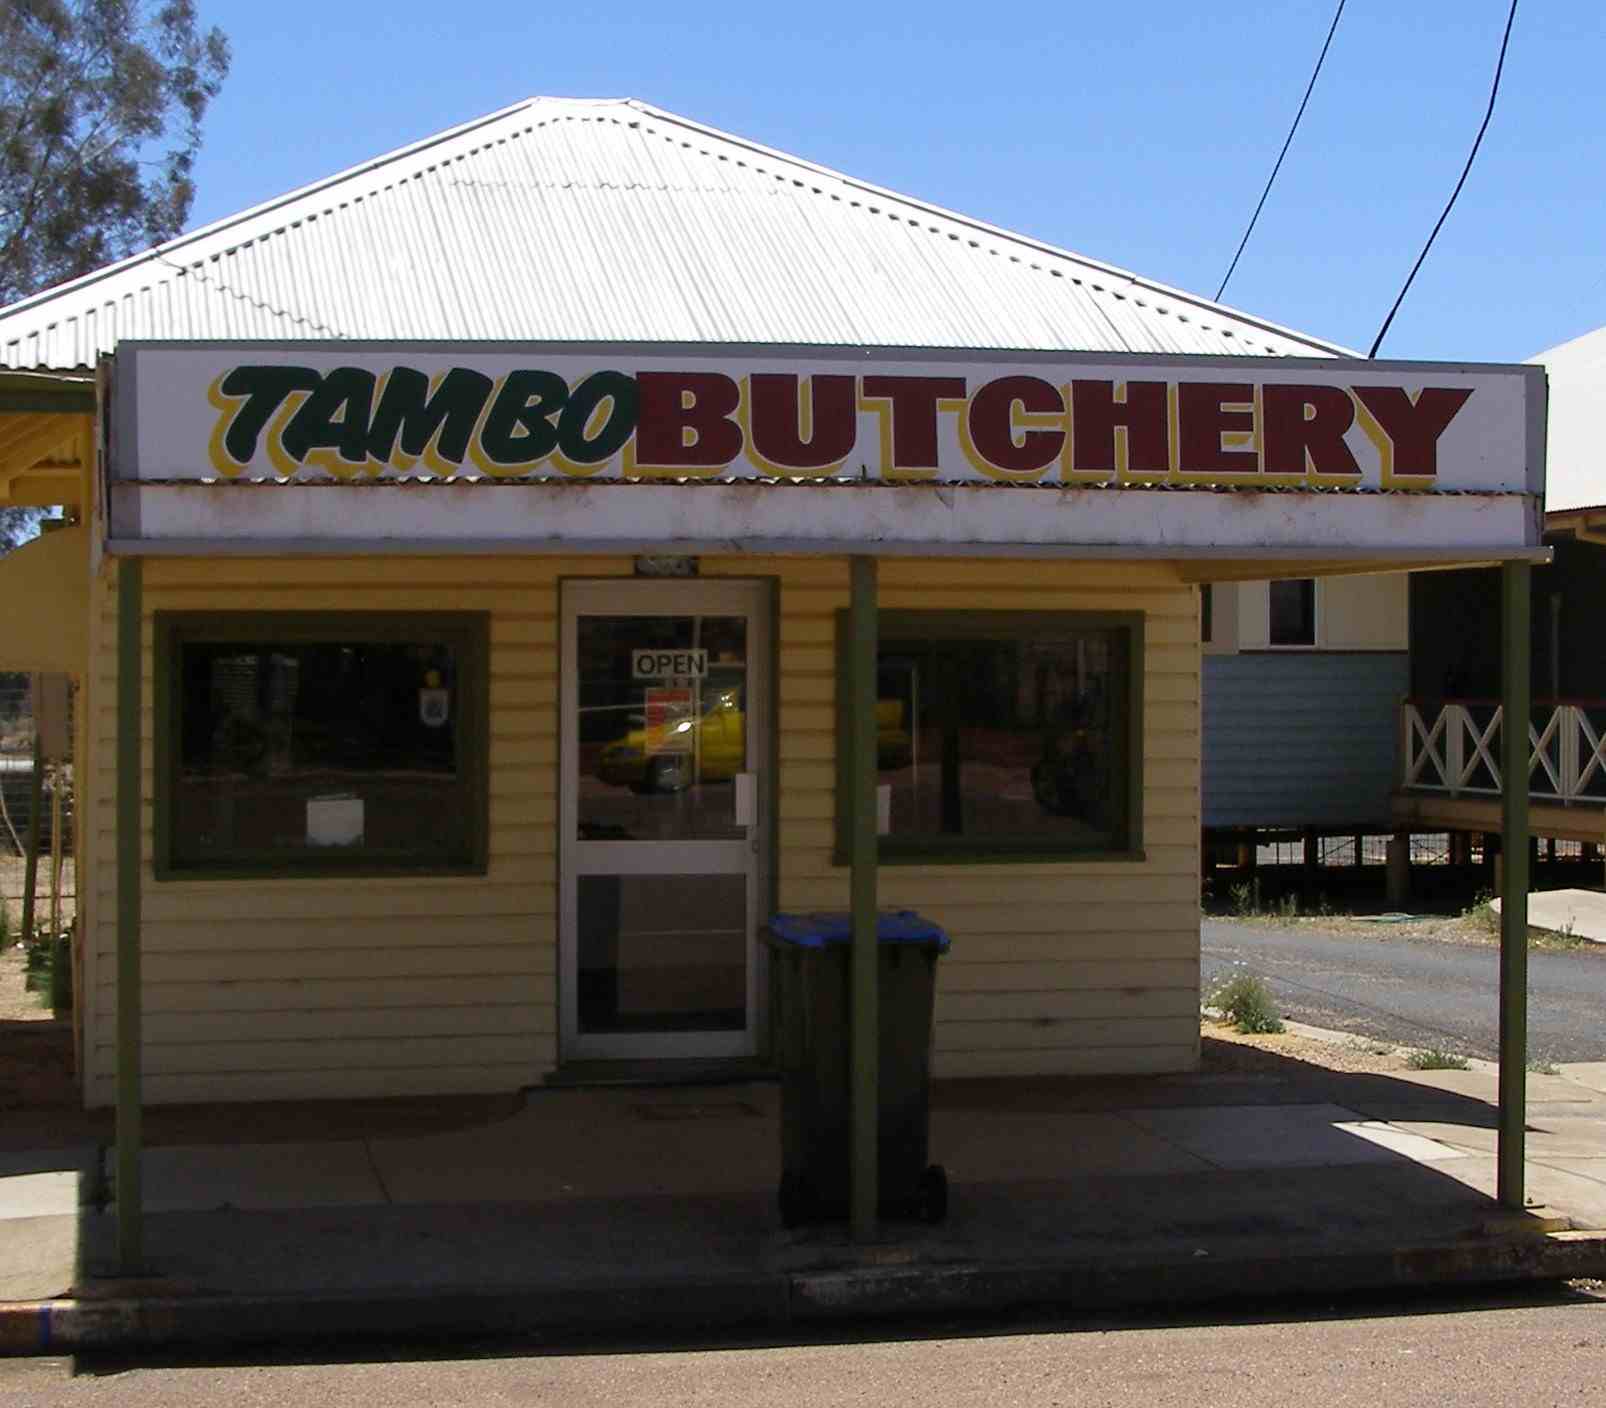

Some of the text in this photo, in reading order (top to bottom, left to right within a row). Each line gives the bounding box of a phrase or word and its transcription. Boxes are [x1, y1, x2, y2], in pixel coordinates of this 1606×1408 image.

[211, 364, 1475, 482] TAMBO BUTCHERY
[637, 654, 705, 675] OPEN
